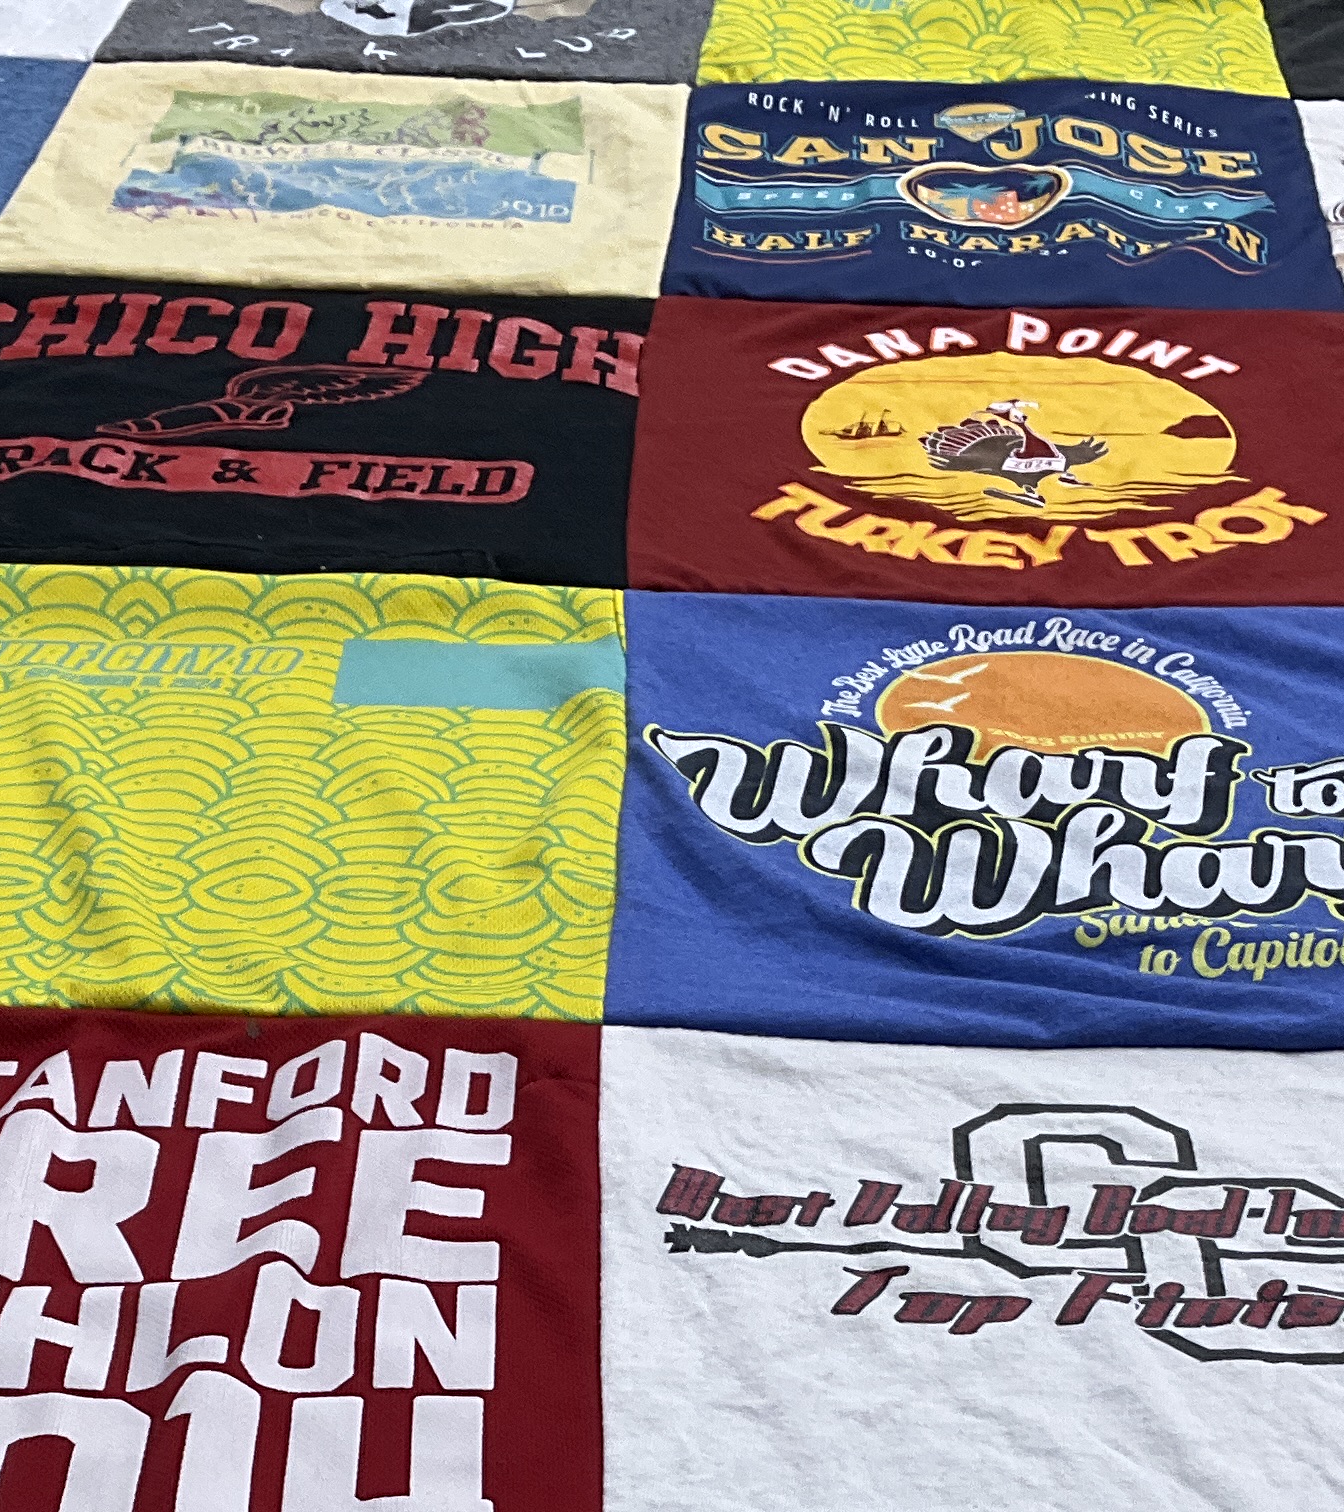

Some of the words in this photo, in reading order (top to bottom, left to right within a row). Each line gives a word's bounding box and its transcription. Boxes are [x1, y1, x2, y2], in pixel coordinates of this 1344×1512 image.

[748, 92, 804, 115] ROCK
[865, 113, 919, 128] ROLL
[1084, 92, 1136, 111] ING
[1148, 105, 1219, 138] SERIES
[699, 122, 941, 166] SAN
[982, 115, 1260, 179] JOSE
[1129, 189, 1219, 214] CITY
[706, 219, 878, 252] HALF
[901, 218, 1267, 266] MARATN
[348, 299, 648, 398] HIGH
[767, 325, 978, 381] DANA
[1008, 311, 1241, 381] POINT
[212, 458, 262, 485] &
[300, 459, 518, 499] FIELD
[751, 481, 1078, 570] TURKEY
[1086, 486, 1329, 567] TROT
[948, 620, 1037, 653] Road
[1037, 616, 1121, 653] Race
[1121, 637, 1157, 664] in
[99, 642, 236, 675] CITY
[233, 646, 304, 675] 10
[831, 661, 889, 694] Best
[821, 690, 862, 718] The
[1154, 652, 1252, 731] California
[649, 721, 1250, 843] Wharf
[1138, 944, 1181, 976] to
[656, 1164, 835, 1227] West
[843, 1179, 1070, 1245] Valley
[830, 1265, 1032, 1335] Top
